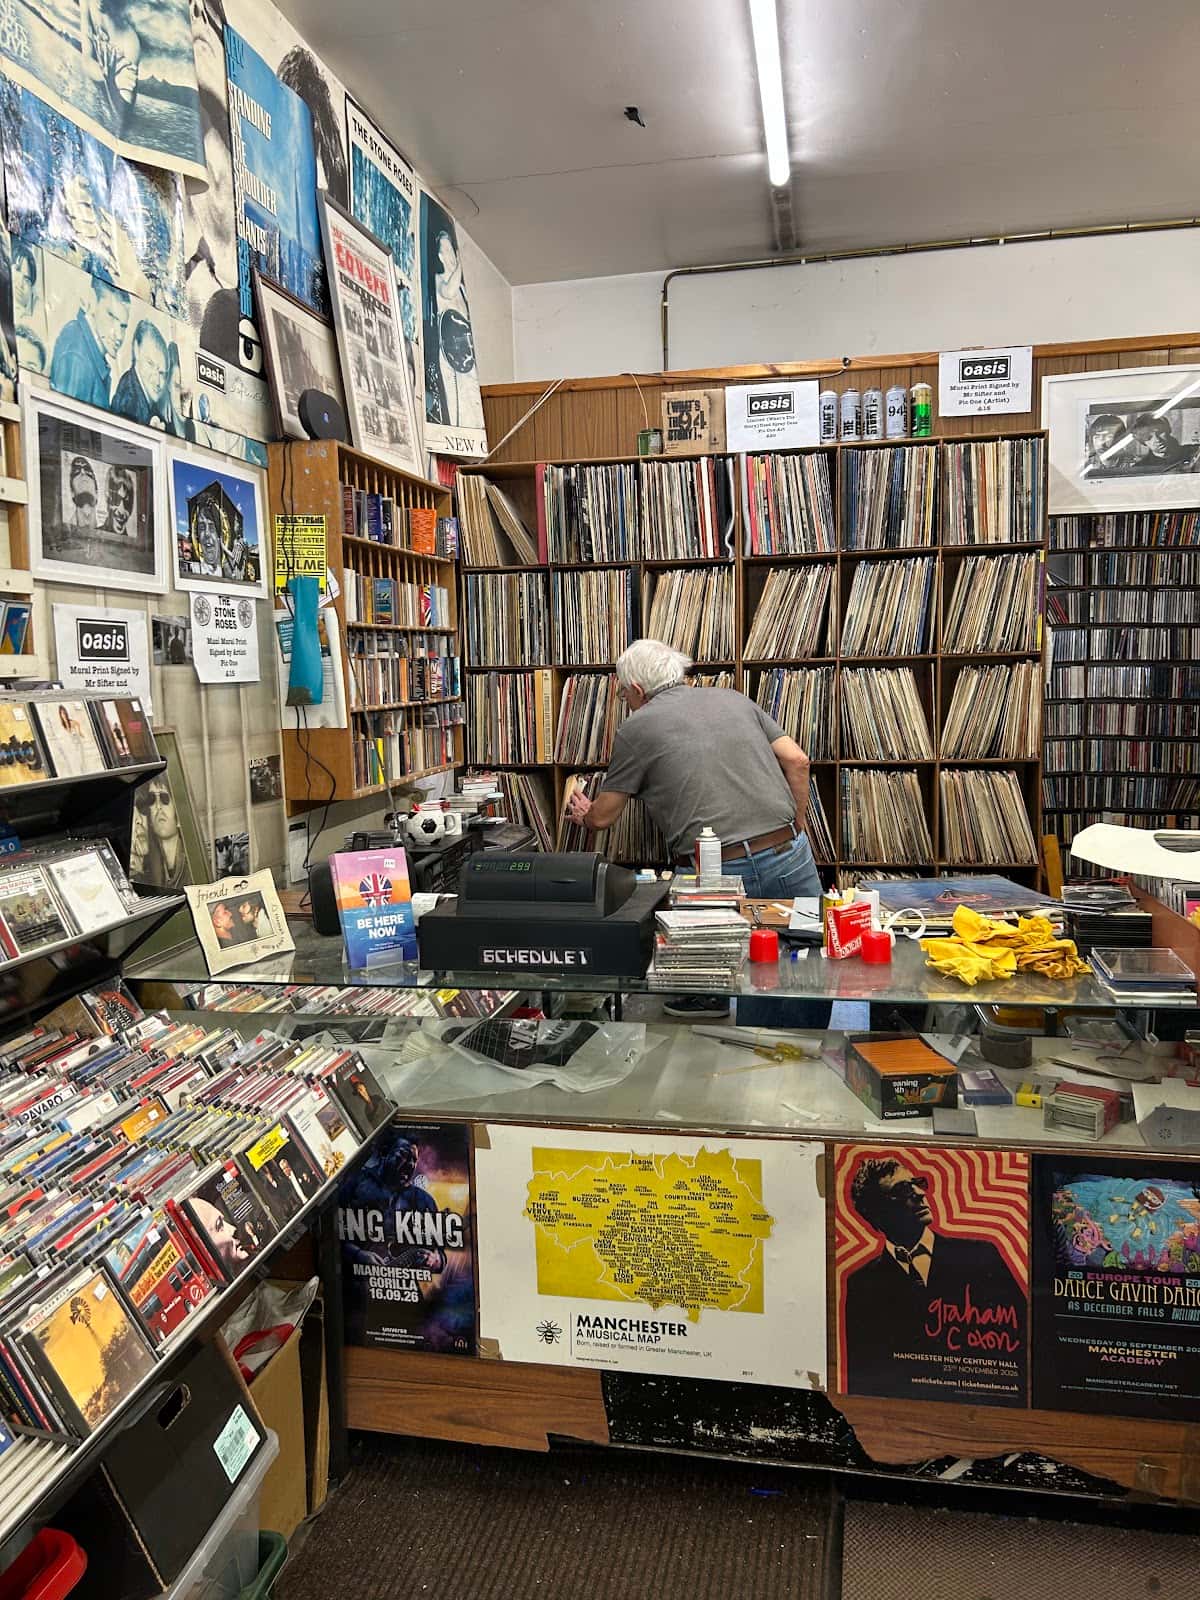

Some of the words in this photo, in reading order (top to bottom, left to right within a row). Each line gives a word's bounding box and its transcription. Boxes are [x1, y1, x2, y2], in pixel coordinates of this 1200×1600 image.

[228, 79, 271, 141] STANDING
[352, 116, 368, 144] THE
[369, 136, 392, 171] STONE
[393, 164, 412, 195] ROSES
[233, 160, 277, 217] SHOULDER
[237, 211, 268, 256] GIANTS
[200, 364, 224, 386] oasis
[964, 361, 1006, 376] oasis
[752, 396, 790, 410] oasis
[889, 406, 904, 416] 94
[843, 420, 853, 435] THE
[445, 436, 475, 453] NEW
[277, 560, 324, 570] HULME
[218, 596, 231, 606] THE
[214, 607, 236, 617] STONE
[215, 619, 237, 629] ROSES
[82, 629, 124, 650] oasis
[70, 666, 91, 674] Mural
[111, 666, 131, 676] Signed
[132, 667, 139, 677] by
[97, 679, 115, 687] Sifter
[357, 917, 374, 930] BE
[374, 913, 405, 927] HERE
[368, 926, 396, 939] NOW
[483, 949, 576, 965] SCHEDULE
[338, 1207, 385, 1243] ING
[395, 1210, 464, 1249] KING
[353, 1263, 432, 1282] MANCHESTER
[1086, 1272, 1141, 1283] EUROPE
[1143, 1275, 1181, 1286] TOUR
[368, 1276, 418, 1292] GORILLA
[1054, 1278, 1104, 1300] DANCE
[1109, 1282, 1158, 1303] GAVIN
[368, 1287, 419, 1303] 16.09.26
[925, 1284, 1018, 1337] graham
[1067, 1301, 1080, 1311] AS
[1083, 1302, 1133, 1315] DECEMBER
[1137, 1306, 1164, 1318] FALLS
[576, 1314, 688, 1337] MANCHESTER
[577, 1329, 584, 1337] A
[586, 1329, 635, 1342] MUSICAL
[637, 1334, 661, 1344] MAP
[1059, 1336, 1114, 1346] WEDNESDAY
[1129, 1342, 1184, 1352] SEPTEMBER
[645, 1345, 666, 1353] Greater
[667, 1347, 702, 1357] Manchester,
[1088, 1345, 1177, 1359] MANCHESTER
[893, 1352, 942, 1362] MANCHESTER
[943, 1355, 960, 1363] NEW
[962, 1357, 997, 1366] CENTURY
[998, 1360, 1018, 1369] HALL
[1100, 1354, 1164, 1366] ACADEMY
[958, 1366, 999, 1375] NOVEMBER
